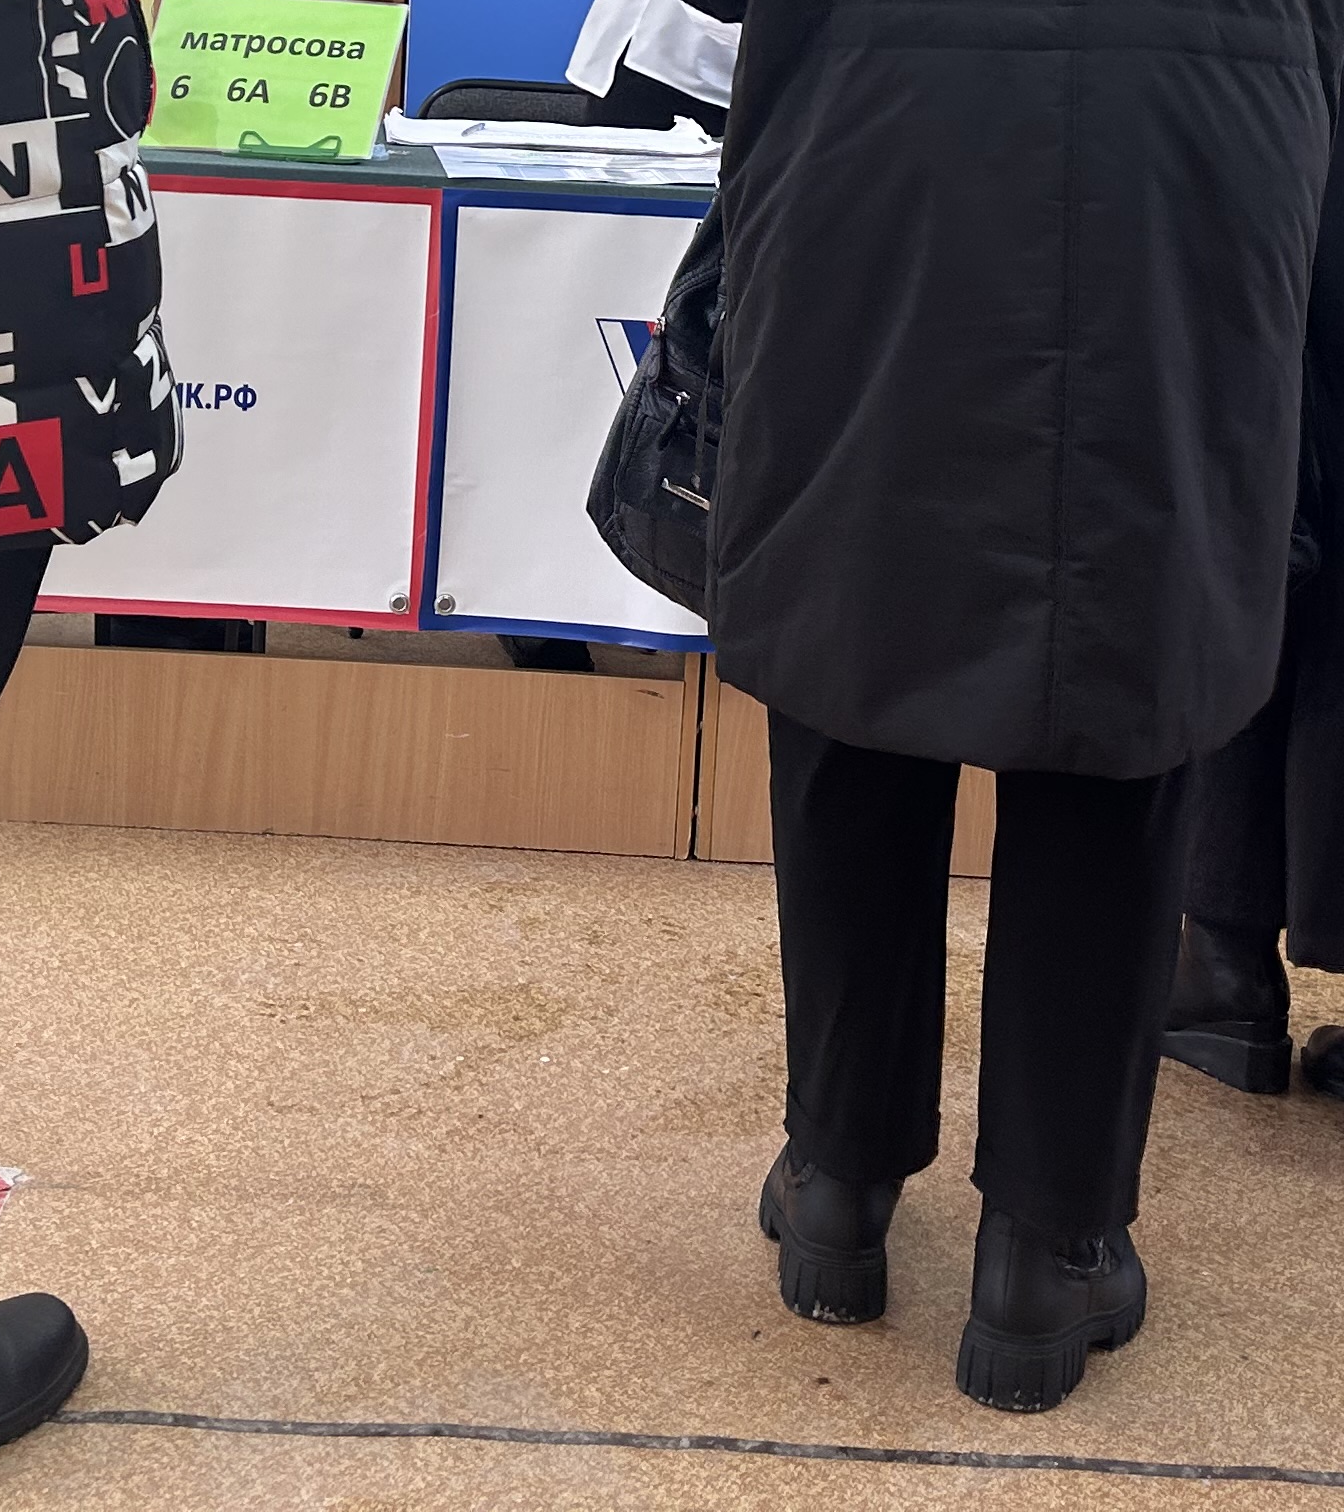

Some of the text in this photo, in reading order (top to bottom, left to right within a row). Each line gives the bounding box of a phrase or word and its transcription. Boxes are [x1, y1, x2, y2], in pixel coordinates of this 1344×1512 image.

[180, 31, 366, 60] матросова
[170, 75, 352, 109] 6 6А 6В
